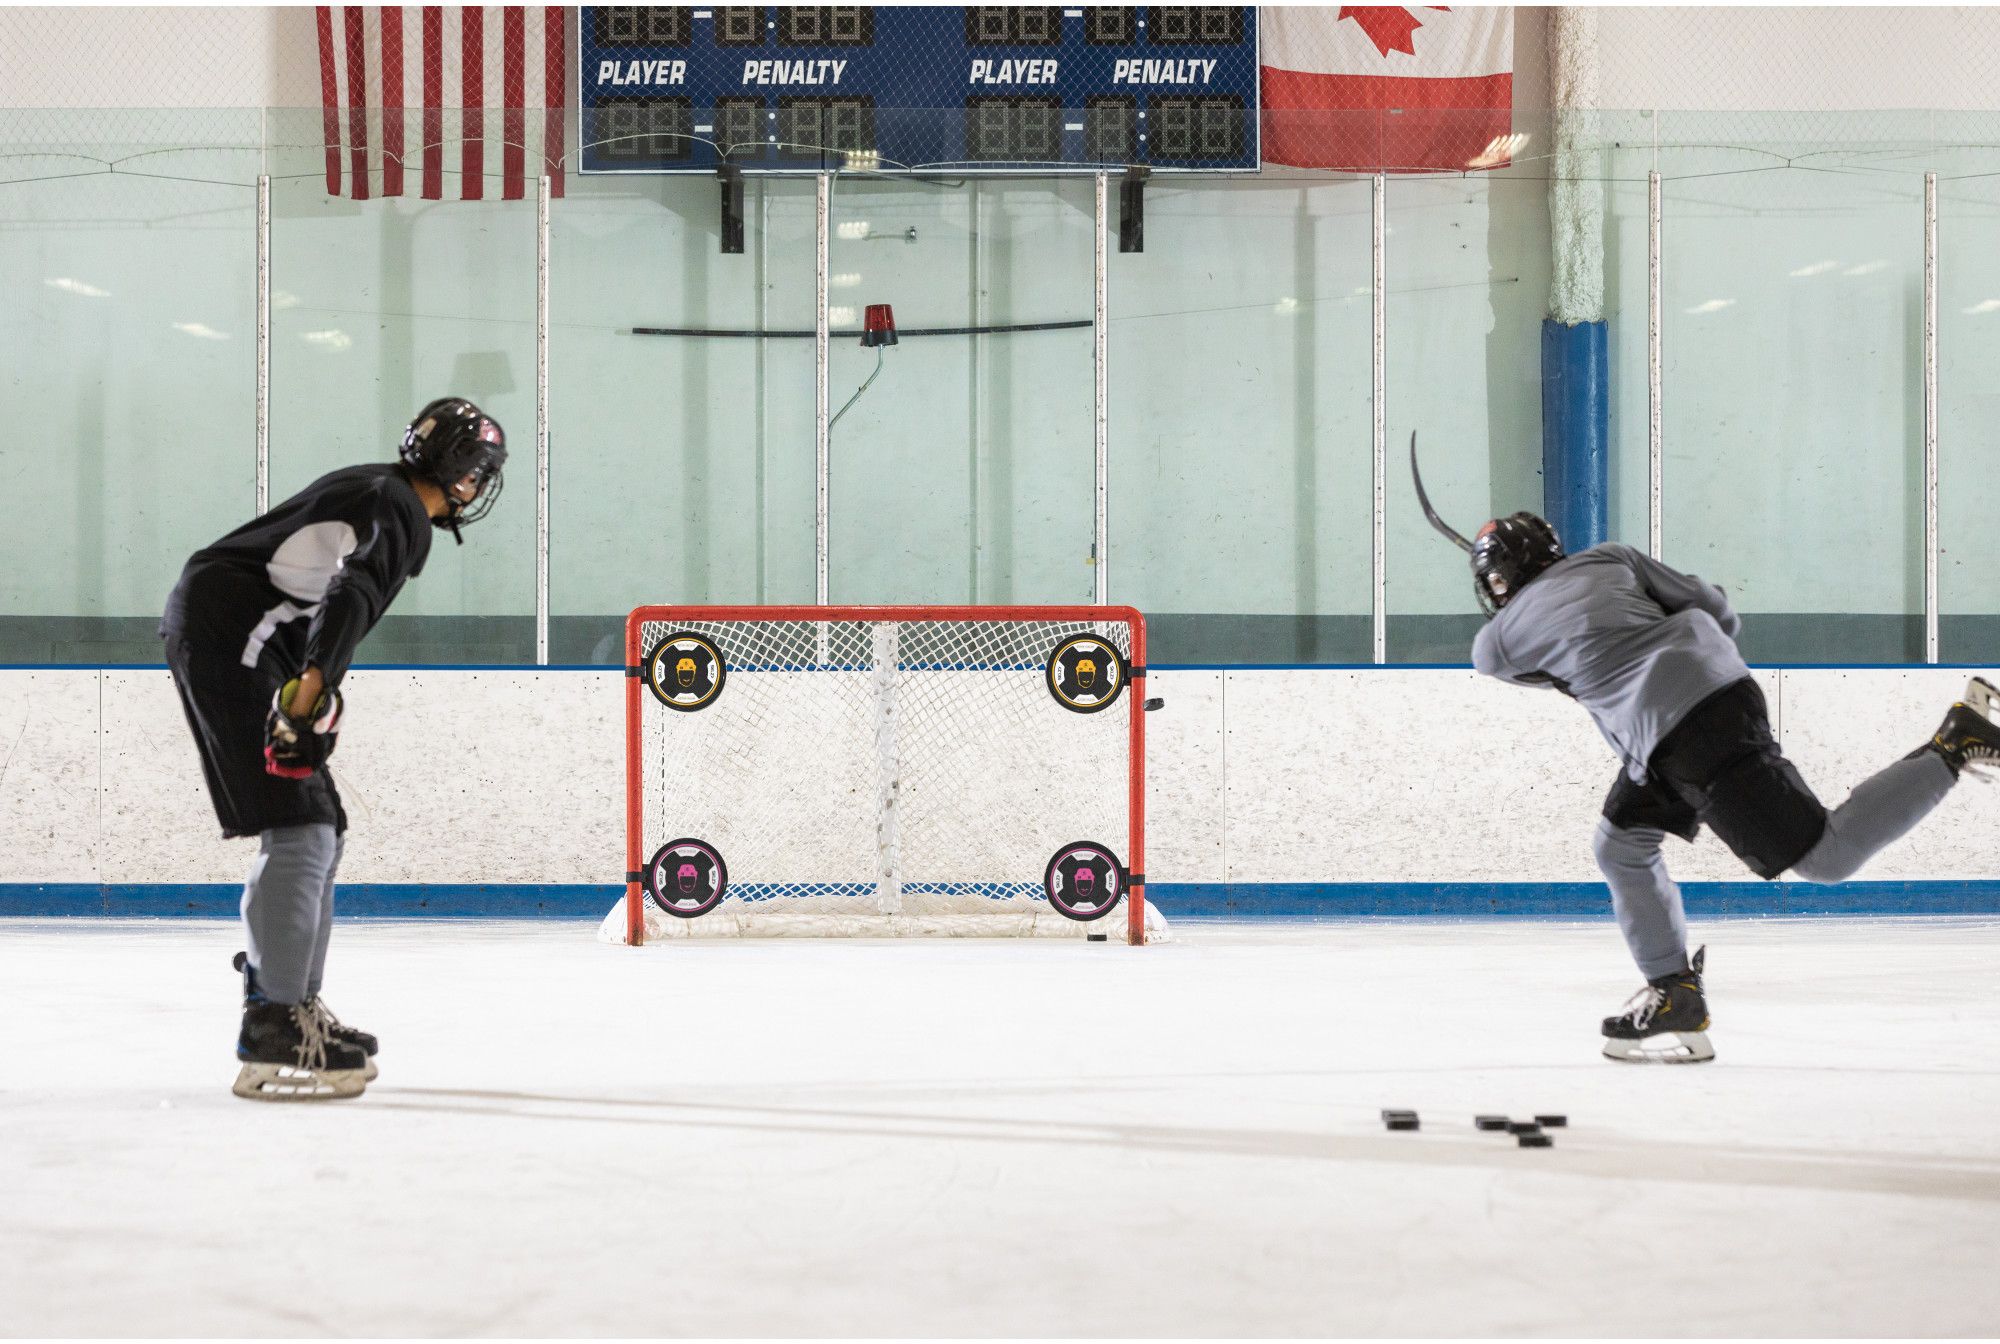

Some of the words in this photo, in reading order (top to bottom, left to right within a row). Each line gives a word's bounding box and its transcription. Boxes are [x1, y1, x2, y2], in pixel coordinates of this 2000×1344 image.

[598, 60, 686, 85] PLAYER
[742, 60, 847, 85] PENALTY
[969, 59, 1058, 84] PLAYER
[1113, 59, 1217, 84] PENALTY
